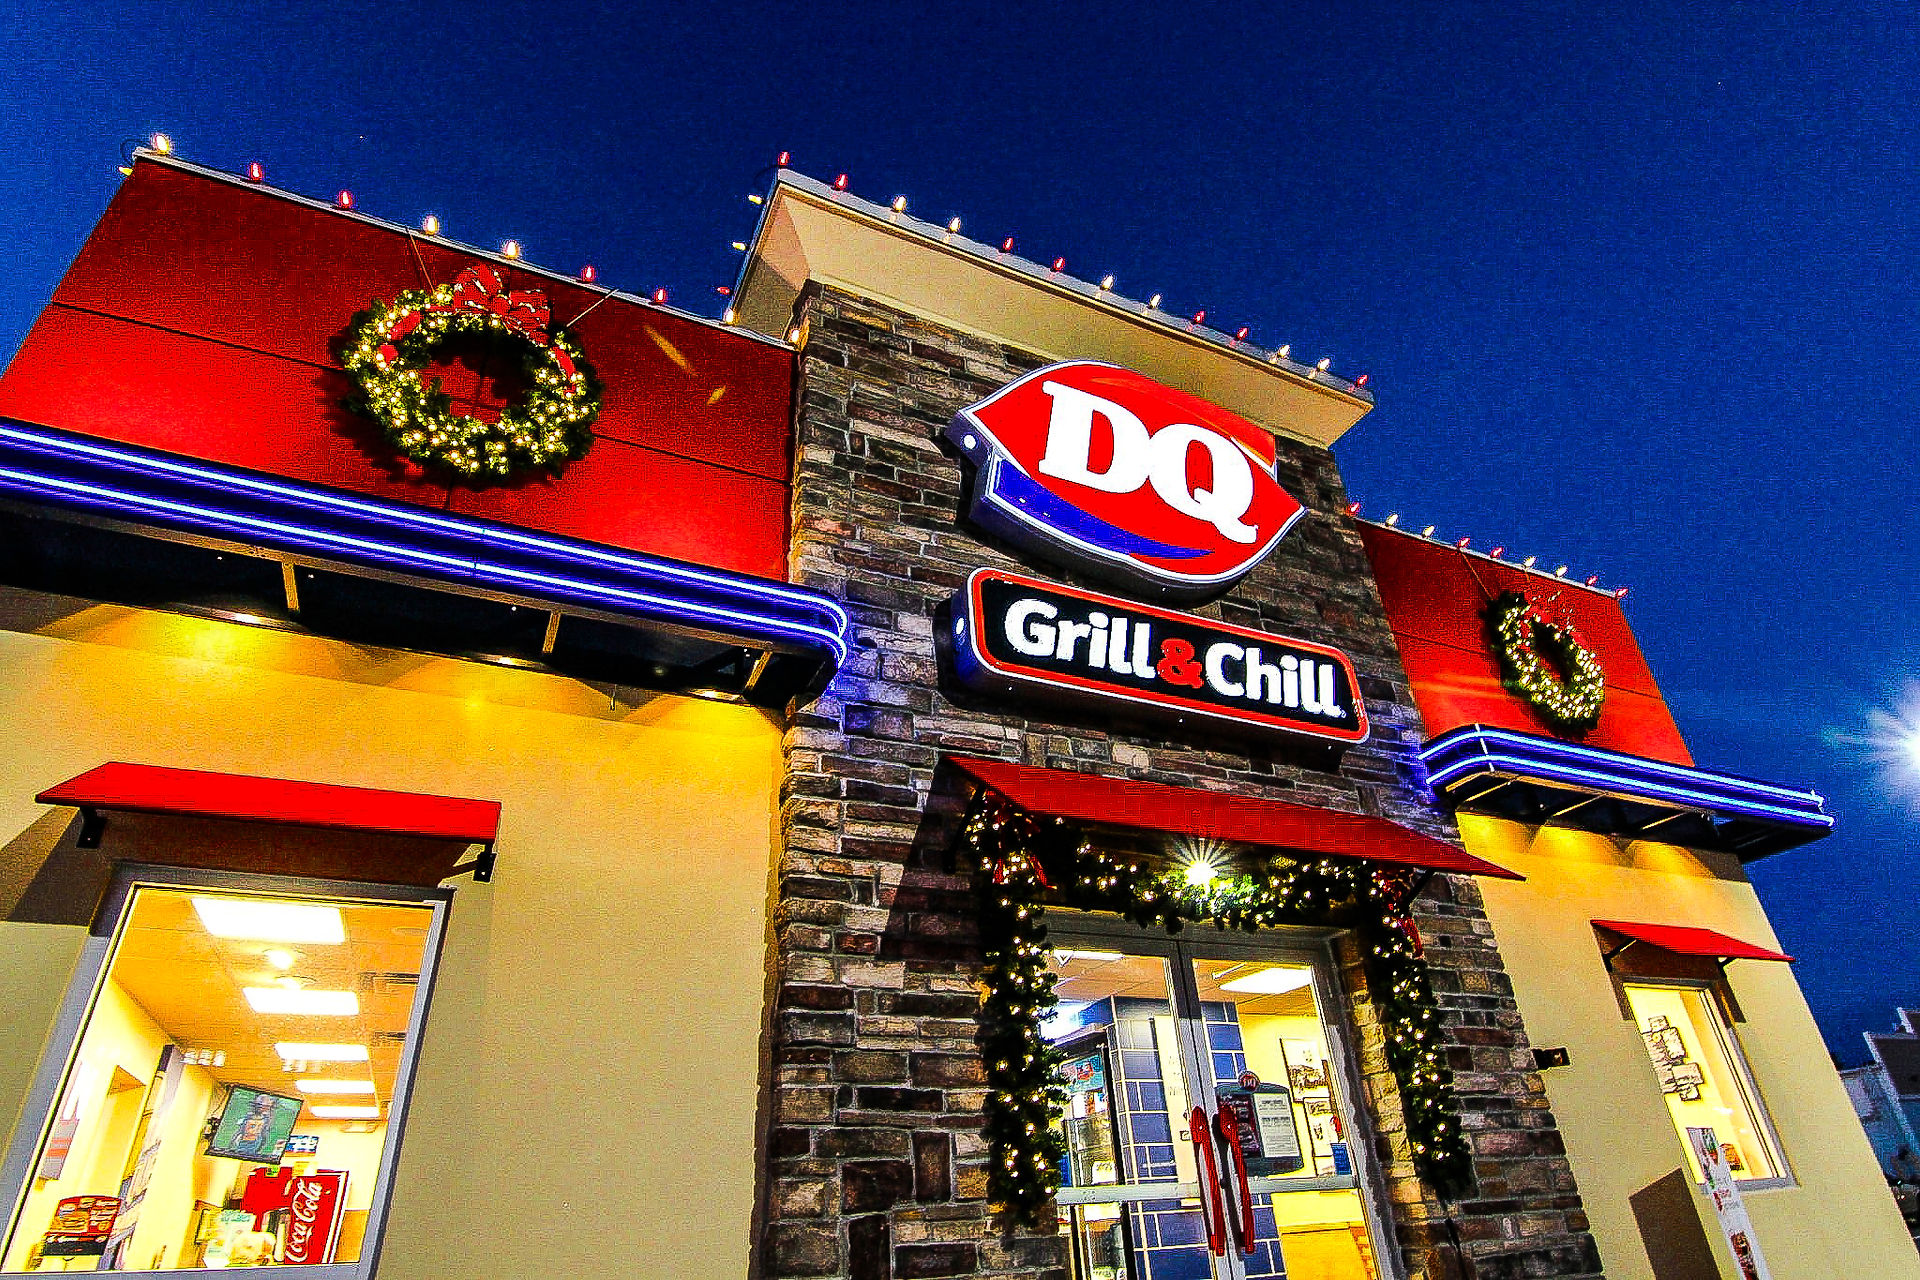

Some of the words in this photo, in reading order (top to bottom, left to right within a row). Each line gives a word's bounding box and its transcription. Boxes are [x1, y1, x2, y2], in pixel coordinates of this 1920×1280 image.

[1038, 380, 1259, 544] DQ
[1004, 597, 1156, 679] Grill
[1156, 637, 1204, 689] &
[1205, 642, 1343, 718] Chill
